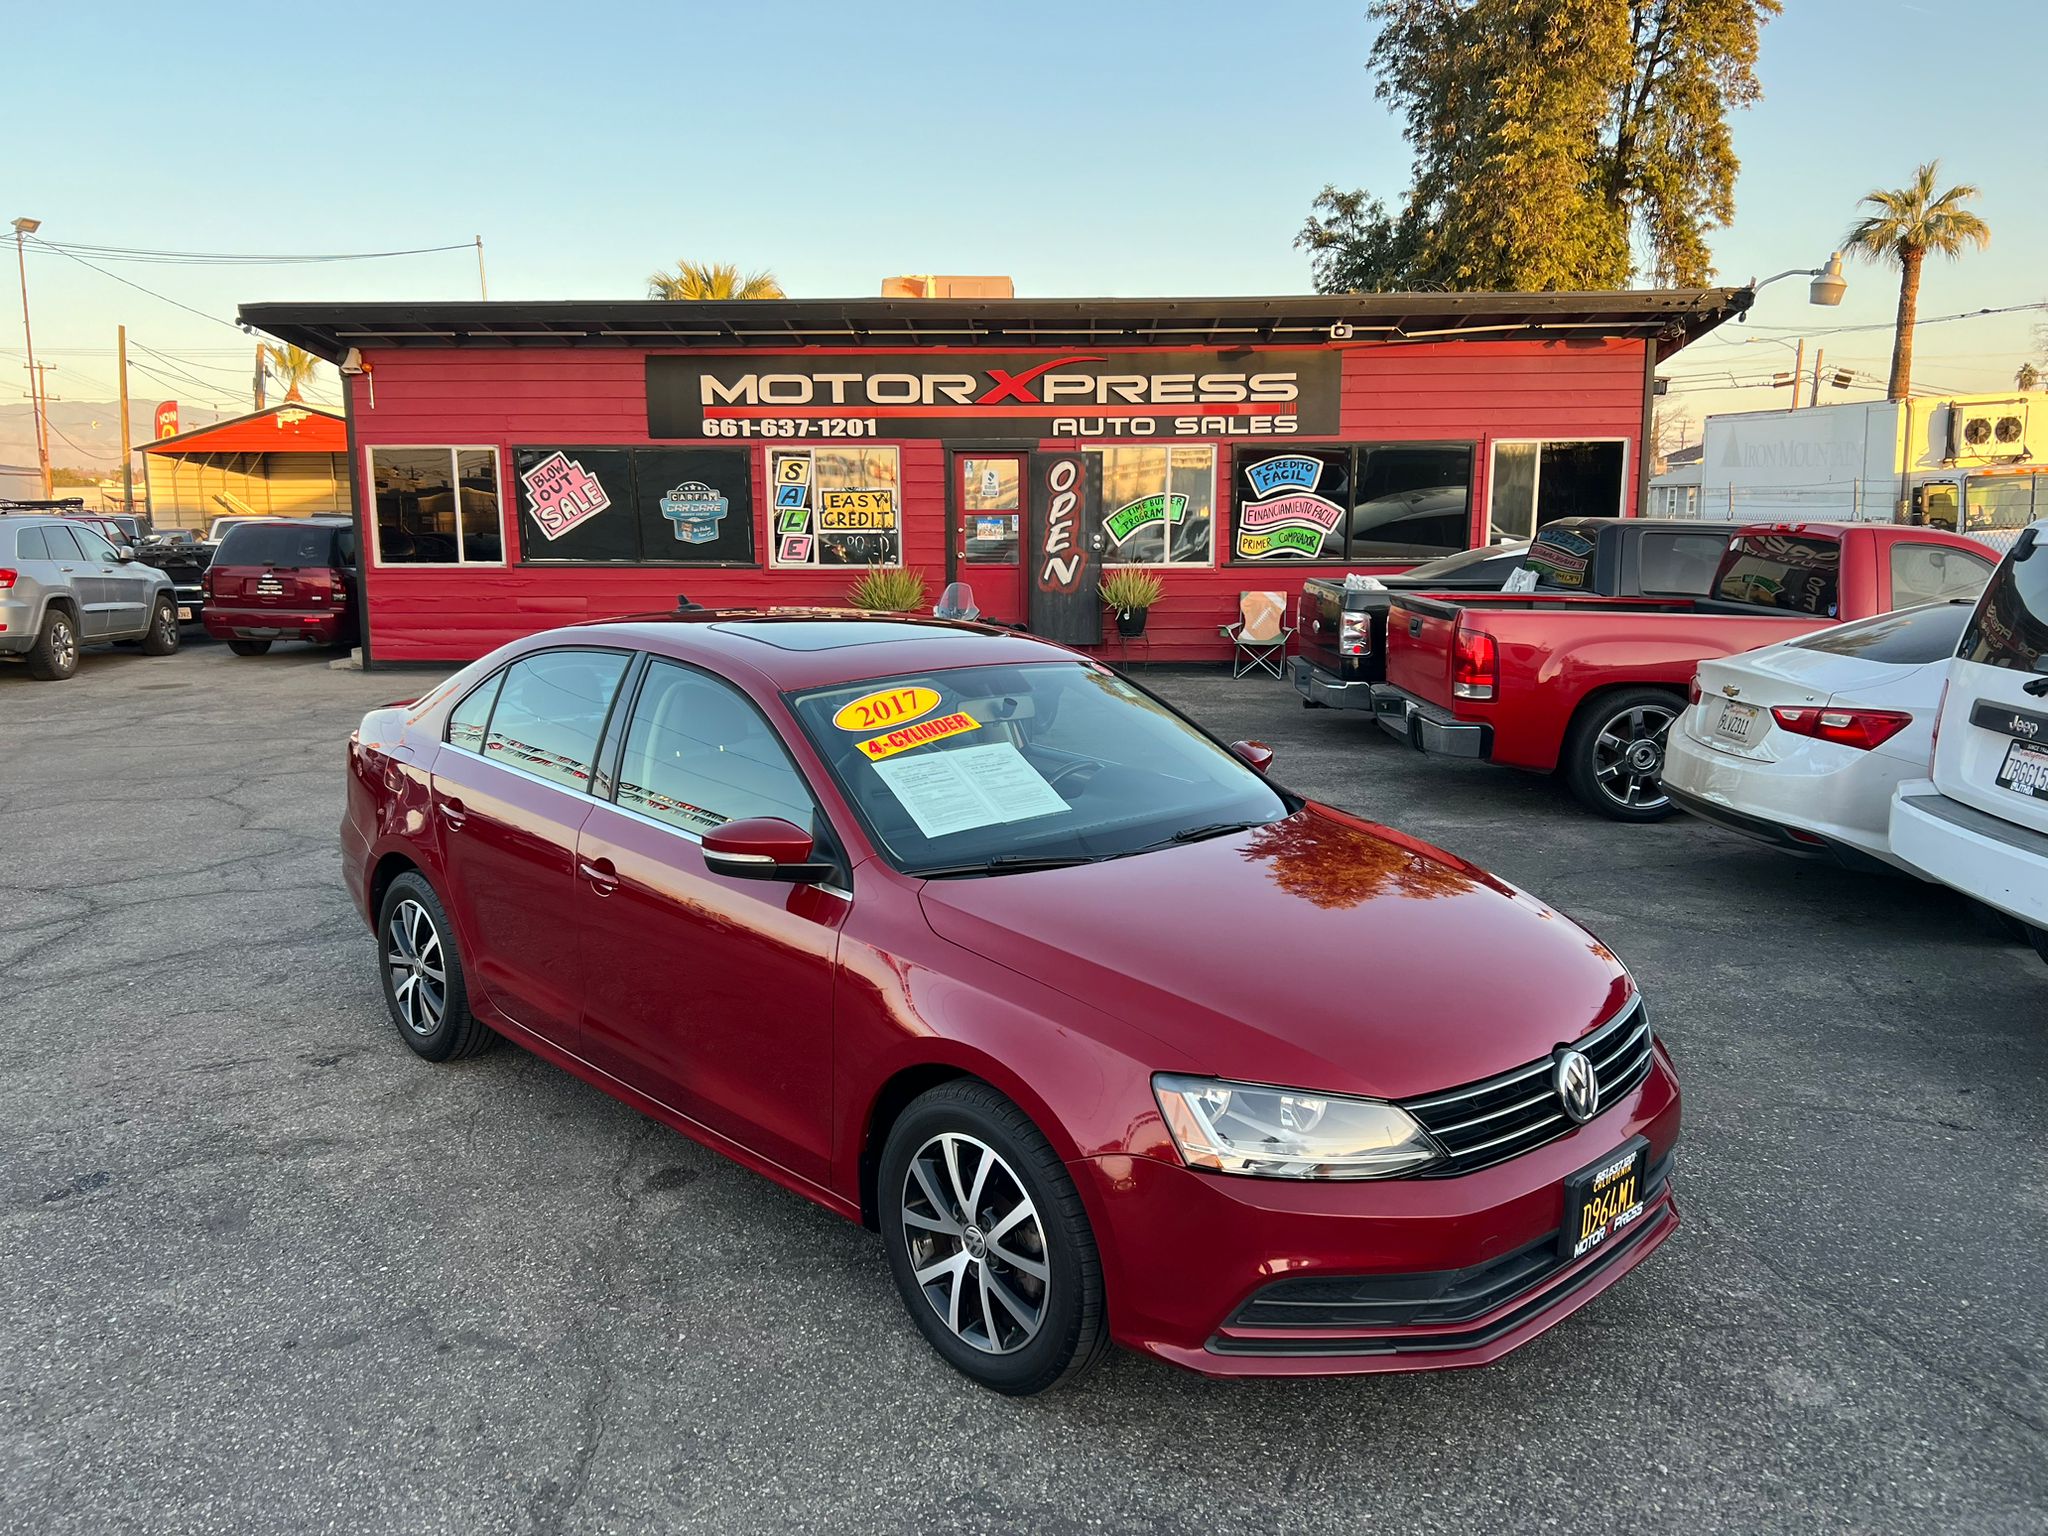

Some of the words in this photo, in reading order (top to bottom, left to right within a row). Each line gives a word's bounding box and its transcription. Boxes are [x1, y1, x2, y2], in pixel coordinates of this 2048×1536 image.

[702, 418, 877, 437] 661-637-1201
[1052, 417, 1156, 436] AUTO
[1174, 415, 1298, 435] SALES
[1744, 442, 1777, 467] IRON
[532, 459, 565, 489] BLOW
[1265, 460, 1314, 473] CREDITO
[540, 472, 573, 501] OUT
[1262, 470, 1307, 486] FACIL
[541, 480, 604, 530] SALE
[667, 503, 690, 512] CAR
[691, 503, 721, 512] CARE
[672, 493, 718, 501] CARFAX
[830, 494, 889, 508] EASY
[824, 512, 890, 527] CREDIT
[1122, 508, 1164, 530] PROGRAM
[1127, 502, 1147, 517] TIME
[1247, 501, 1313, 522] FINANCIAMIENTO
[1311, 505, 1335, 526] FACIL
[1044, 460, 1080, 585] OPEN
[1242, 532, 1273, 549] PRIMER
[855, 689, 918, 727] 2017
[868, 714, 970, 755] 4-CYLINDER
[2009, 714, 2039, 739] Jeep
